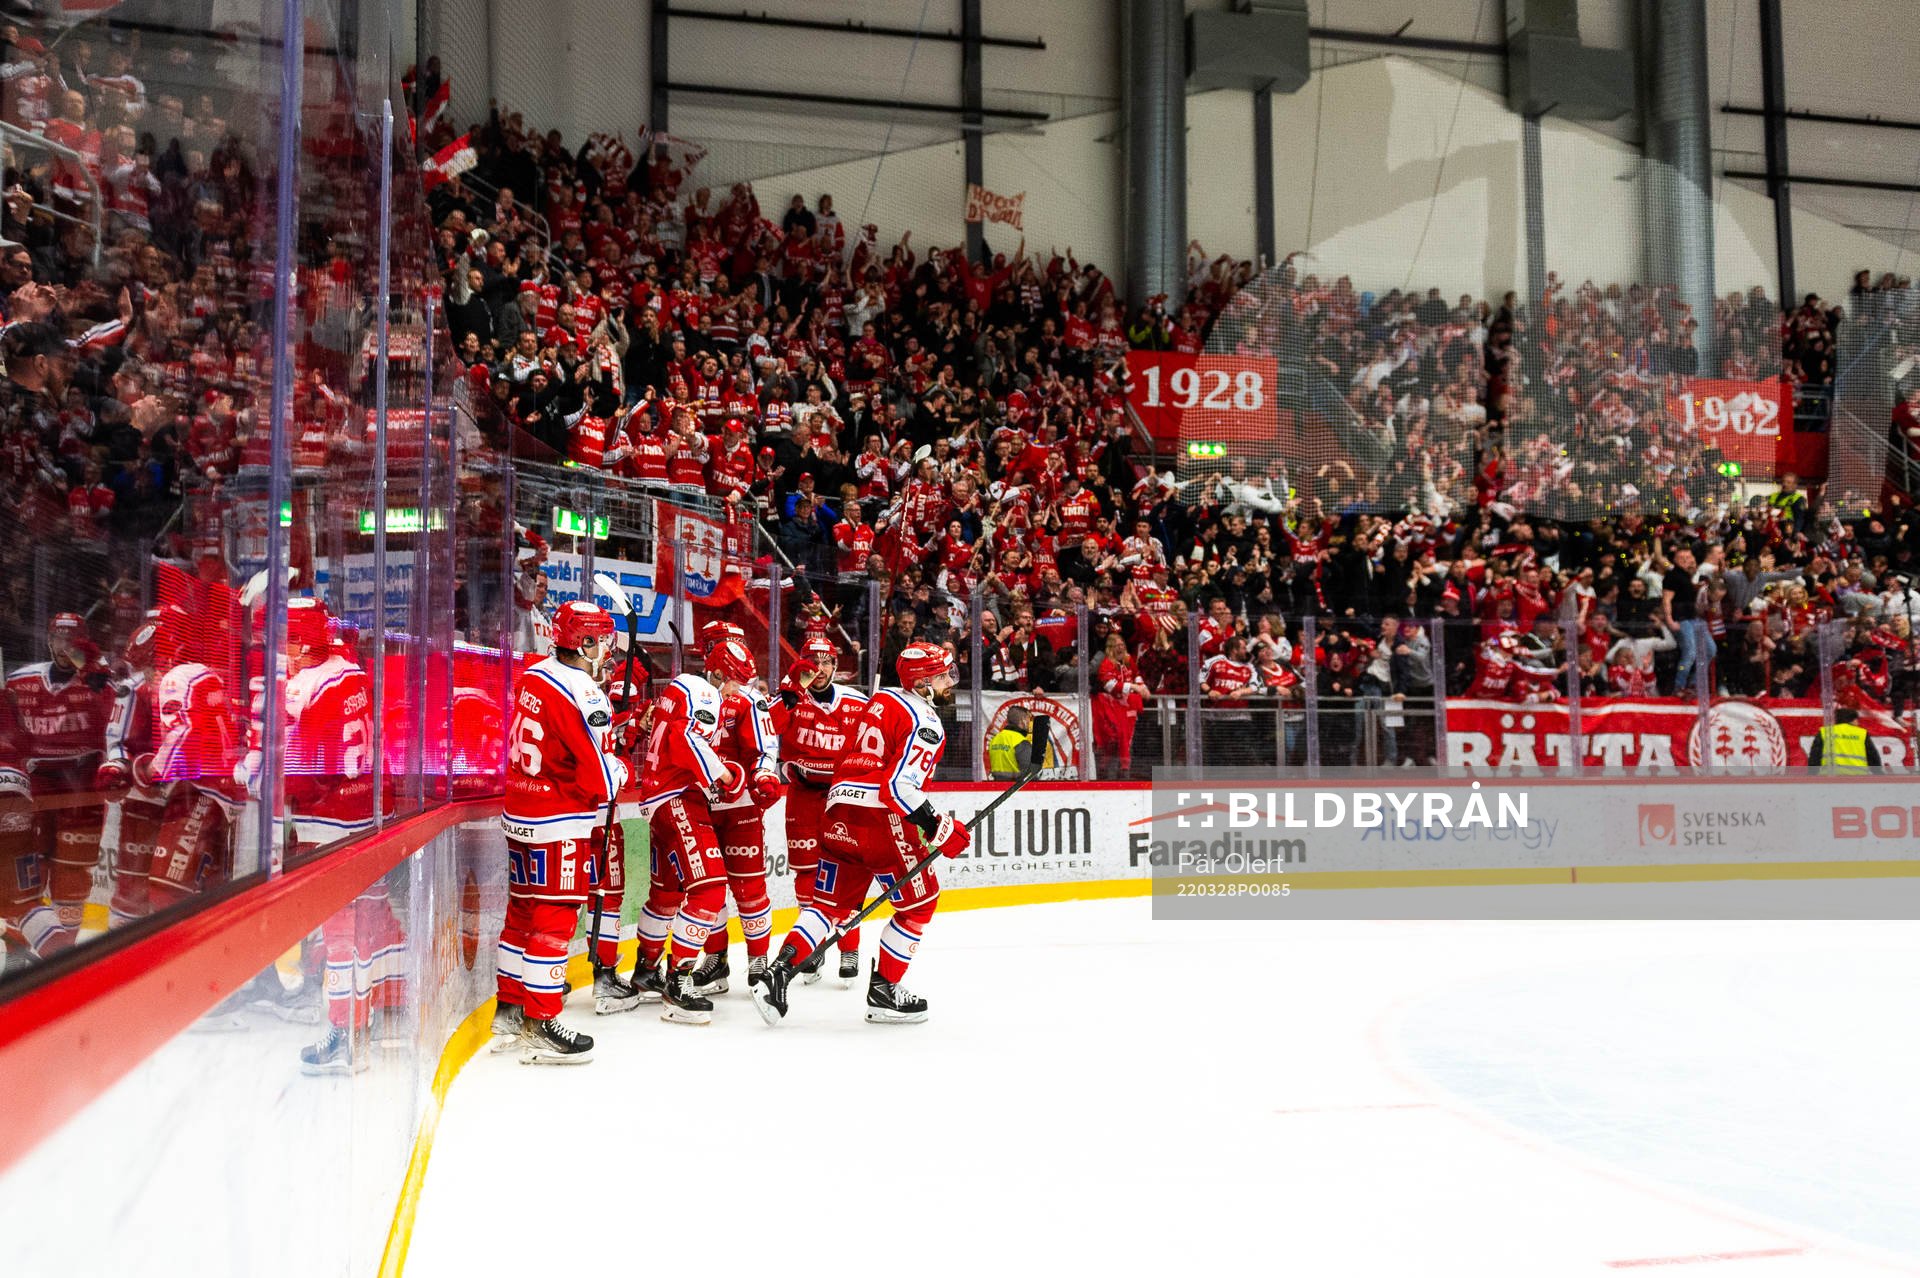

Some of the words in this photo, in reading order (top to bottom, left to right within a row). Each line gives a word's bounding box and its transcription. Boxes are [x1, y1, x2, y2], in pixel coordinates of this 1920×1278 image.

[1142, 365, 1264, 410] 1928
[1679, 391, 1780, 436] 1962
[797, 727, 846, 751] TIMR
[1447, 713, 1680, 777] RÄTTA
[908, 745, 934, 773] 78
[1683, 812, 1766, 827] SVENSKA
[673, 803, 704, 870] PEAB
[1128, 832, 1307, 867] Faradium
[1683, 831, 1727, 846] SPEL
[725, 845, 760, 858] coop
[949, 860, 1093, 874] FASTIGHETER
